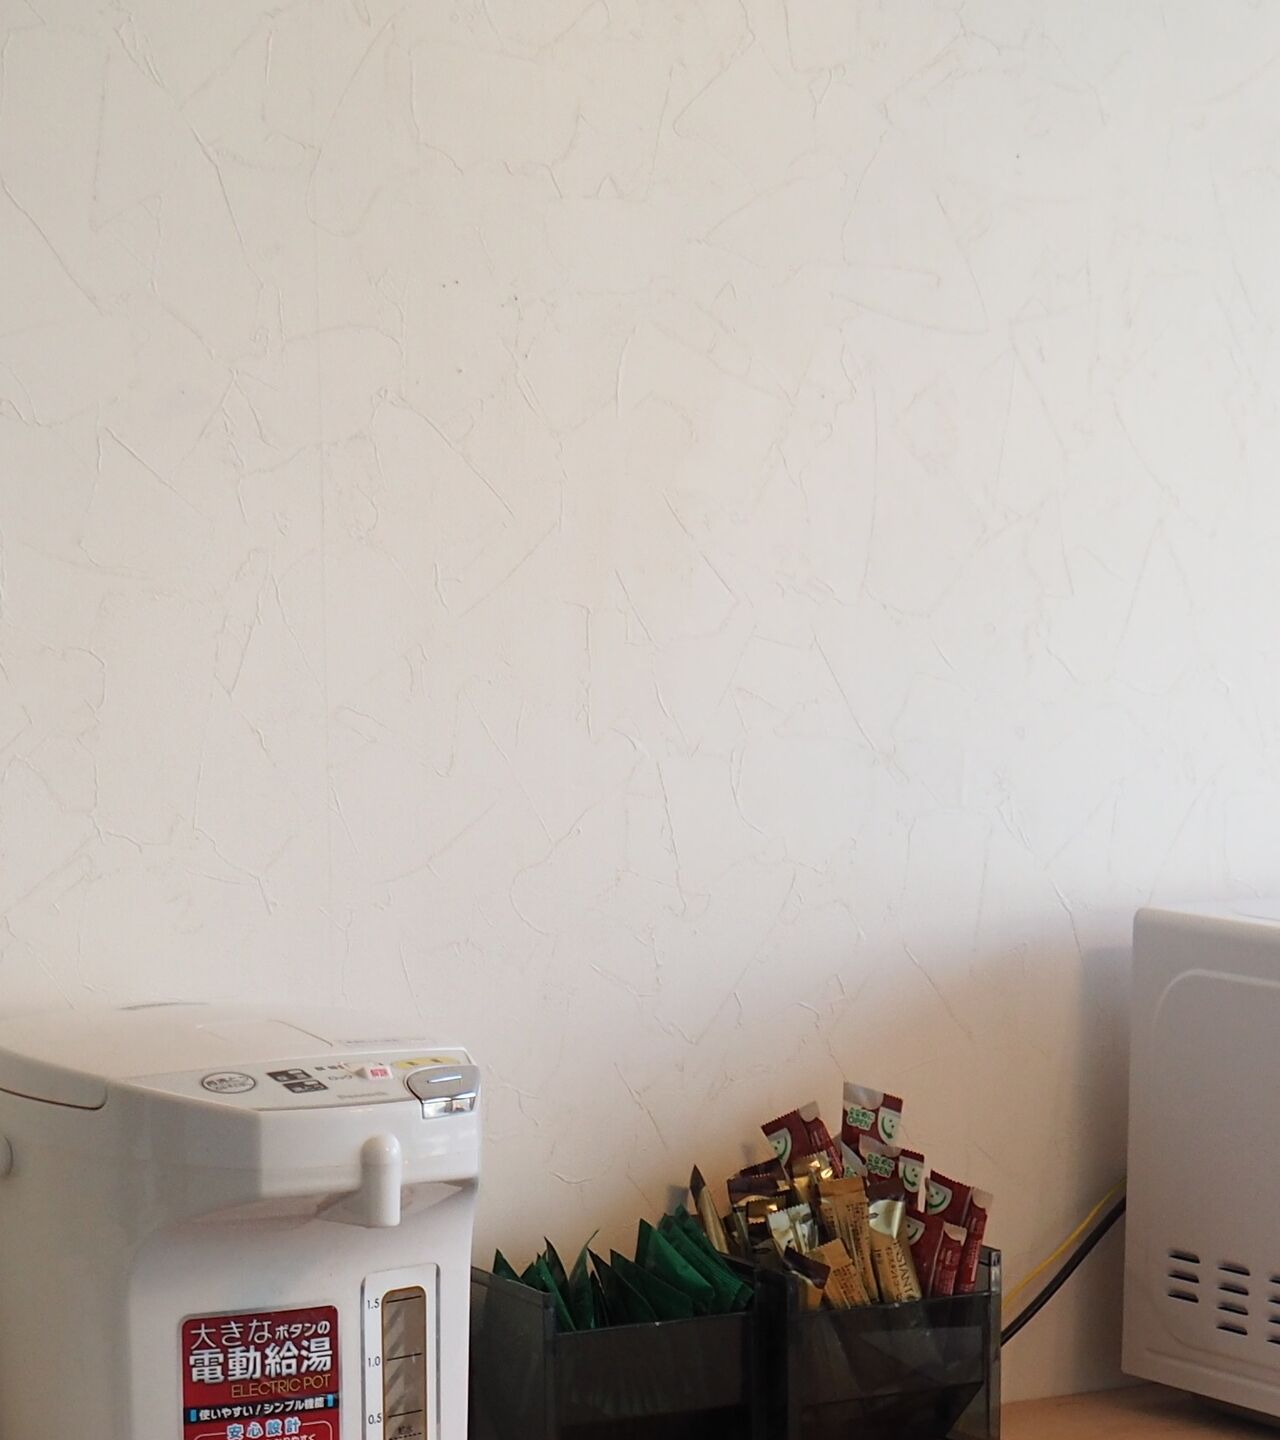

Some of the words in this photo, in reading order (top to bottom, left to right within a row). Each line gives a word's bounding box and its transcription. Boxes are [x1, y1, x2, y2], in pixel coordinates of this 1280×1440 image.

[367, 1299, 380, 1311] 1.5
[190, 1319, 331, 1350] 大きなボタンの
[189, 1336, 333, 1384] 電動給湯
[368, 1356, 381, 1367] 1.0
[231, 1380, 301, 1398] ELECTRIC
[303, 1373, 332, 1390] POT
[368, 1413, 382, 1425] 0.5
